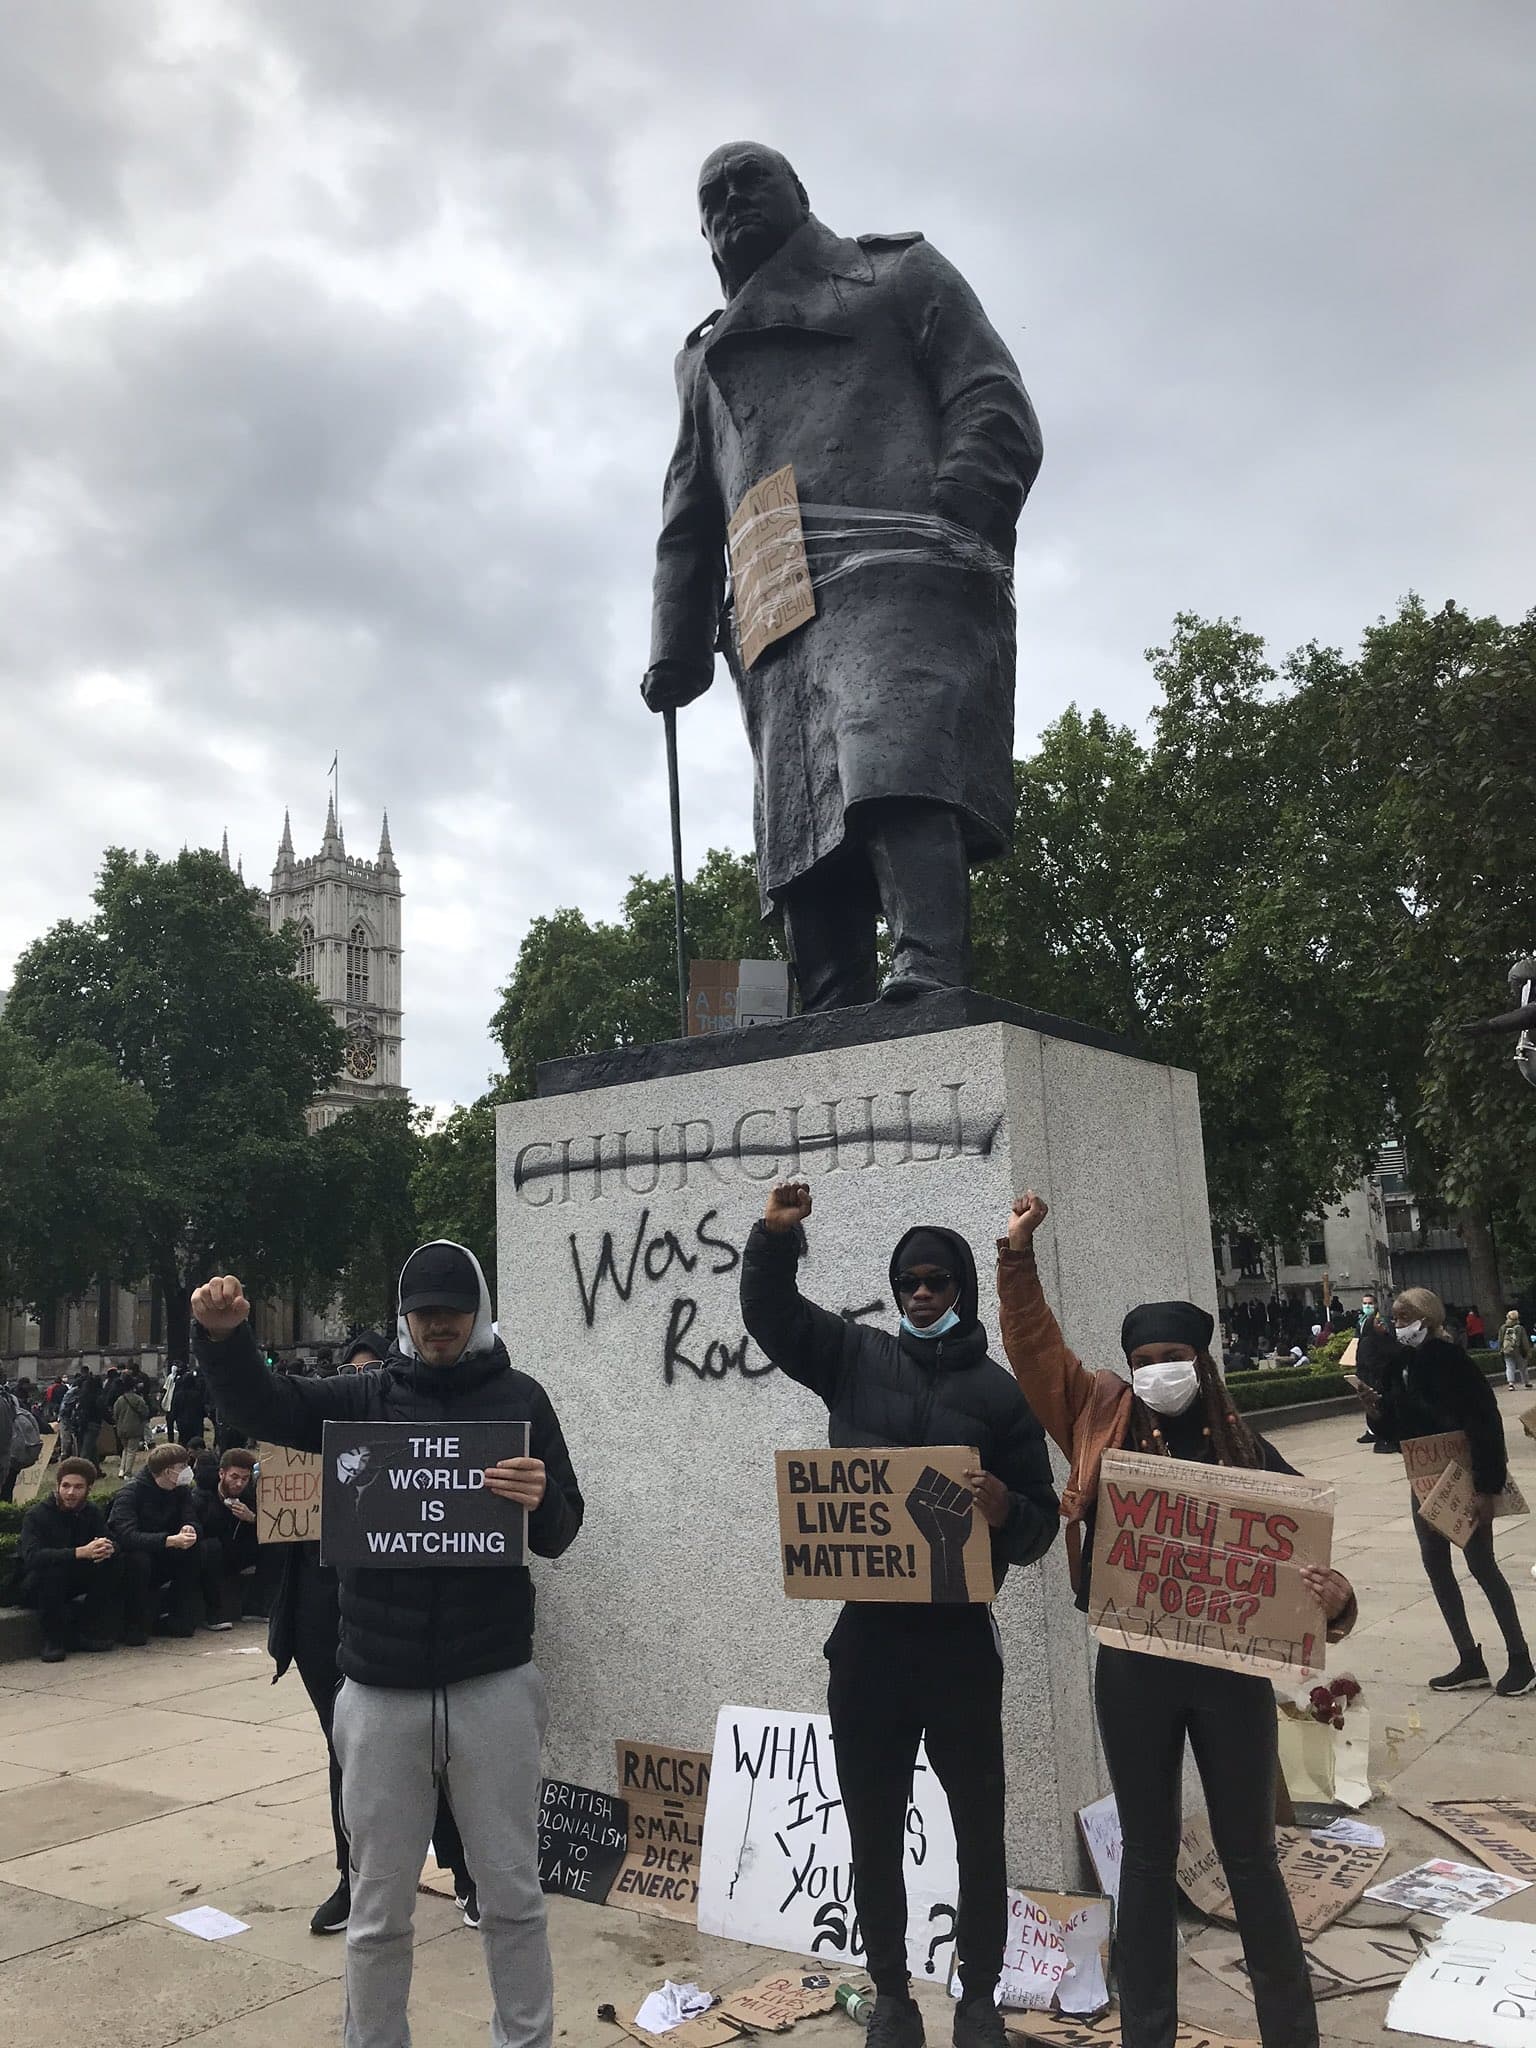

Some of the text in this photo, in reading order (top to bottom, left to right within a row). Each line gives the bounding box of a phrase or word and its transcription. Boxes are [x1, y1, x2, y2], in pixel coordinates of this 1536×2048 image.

[513, 1082, 988, 1207] CHURCHILL
[569, 1209, 740, 1328] Was
[408, 1437, 460, 1459] THE
[388, 1469, 486, 1490] WORLD
[788, 1458, 893, 1495] BLACK
[421, 1500, 445, 1522] IS
[796, 1501, 892, 1537] LIVES
[1107, 1483, 1299, 1562] WHY IS
[366, 1532, 506, 1554] WATCHING
[784, 1544, 917, 1579] MATTER!
[1106, 1530, 1277, 1598] AFRICA
[1136, 1571, 1260, 1635] POOR?
[733, 1723, 834, 1801] WHA
[543, 1783, 613, 1821] BRITISH
[536, 1808, 627, 1852] OLONIALISM
[567, 1842, 589, 1861] TO
[642, 1844, 693, 1875] DICK
[537, 1857, 593, 1893] LAME
[617, 1868, 700, 1904] ENERGY
[1021, 1924, 1065, 1953] ENDS
